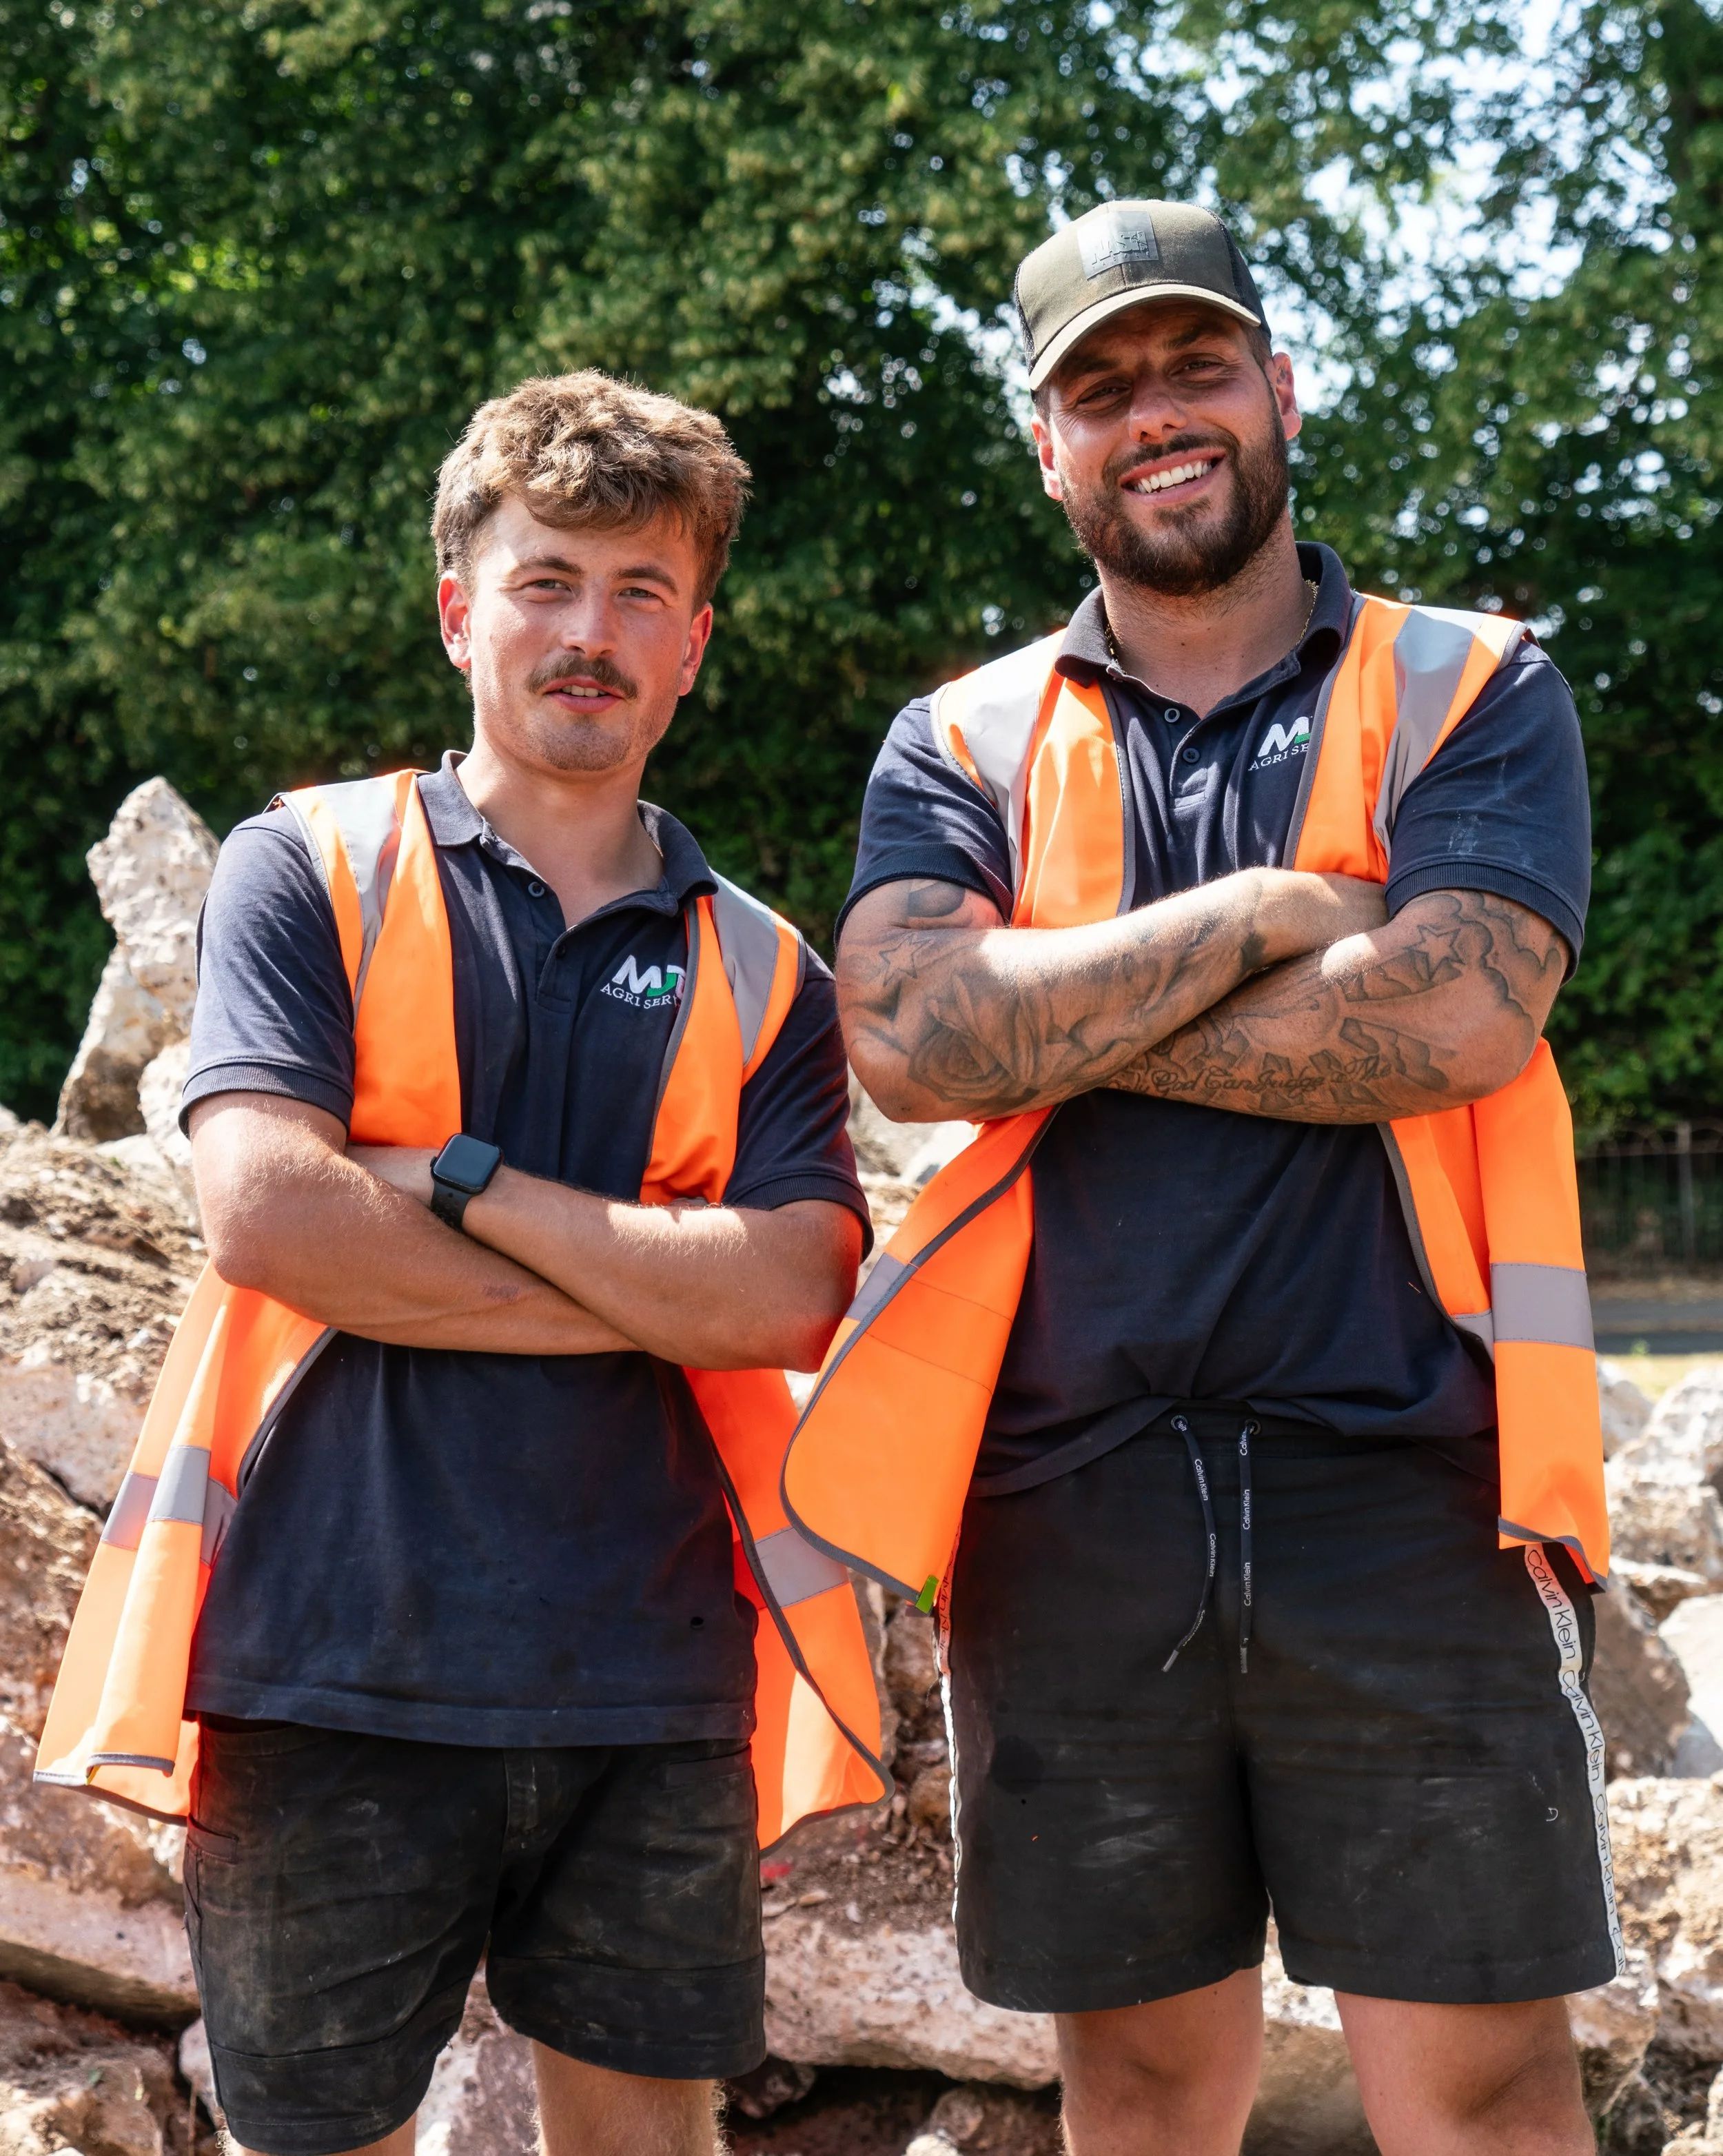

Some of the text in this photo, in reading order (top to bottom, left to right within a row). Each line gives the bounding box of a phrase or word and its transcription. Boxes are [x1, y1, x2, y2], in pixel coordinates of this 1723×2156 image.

[1247, 750, 1289, 771] AGRI
[600, 983, 641, 1007] AGRI
[1152, 1066, 1207, 1096] God
[1205, 1065, 1265, 1093] Can
[1194, 1458, 1209, 1501] Calvin Klein
[1527, 1549, 1576, 1660] Calvin Klein
[1562, 1669, 1604, 1782] Calvin Klein
[1595, 1793, 1615, 1915] Calvin Klein
